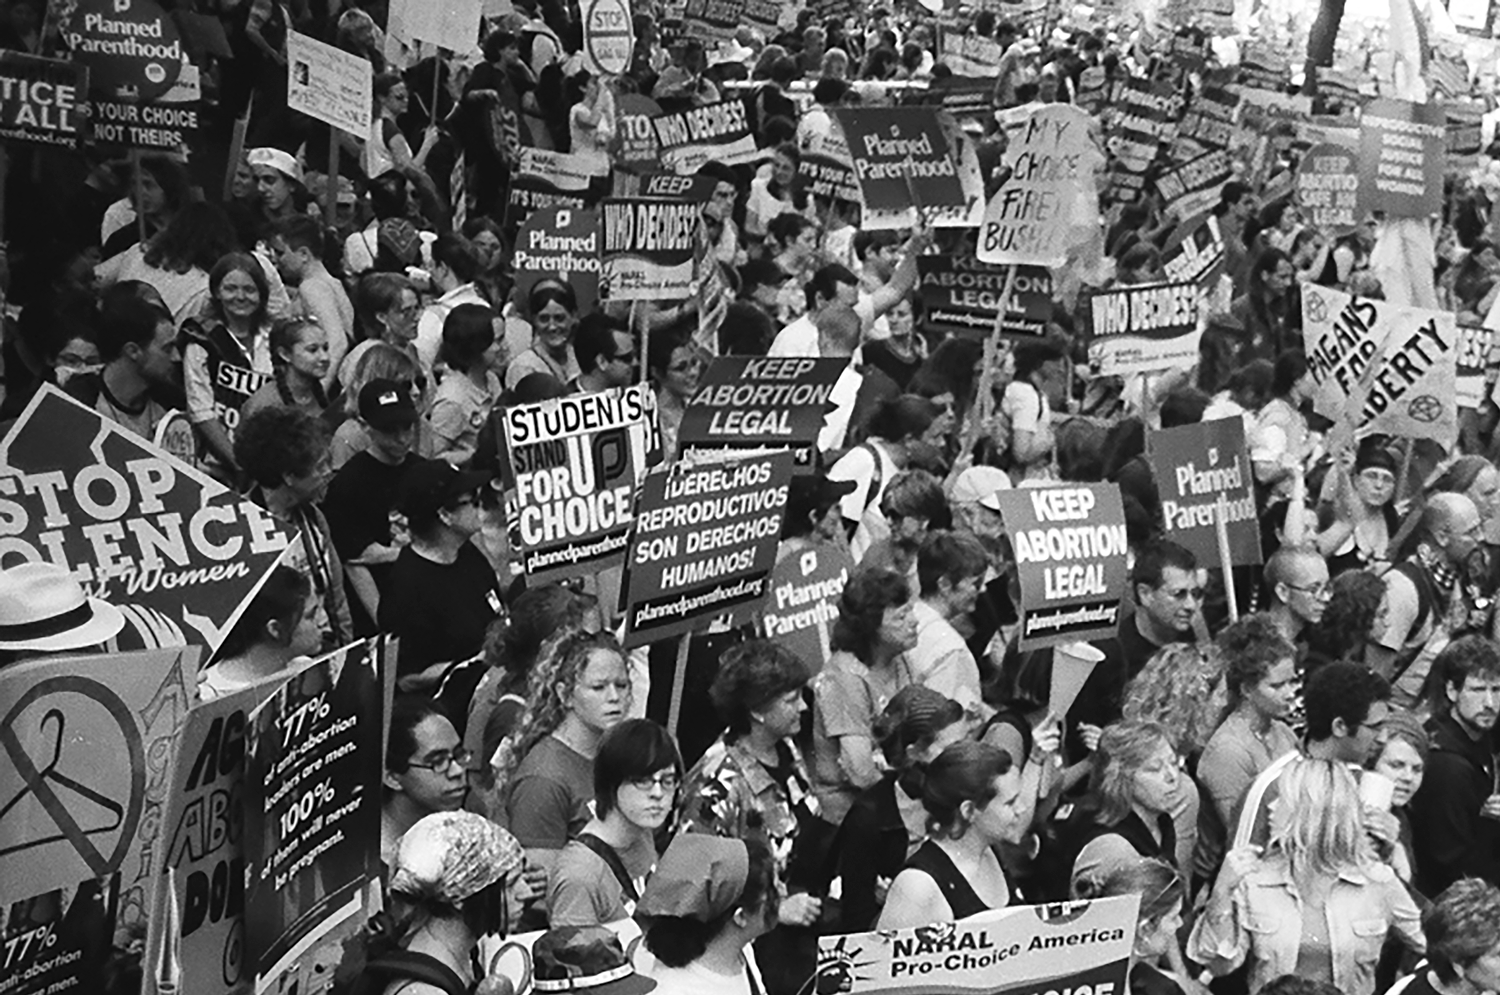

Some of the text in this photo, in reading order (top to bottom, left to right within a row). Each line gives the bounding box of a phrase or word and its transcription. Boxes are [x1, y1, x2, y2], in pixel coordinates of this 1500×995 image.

[85, 14, 162, 37] Planned
[596, 12, 622, 28] STOP
[70, 33, 181, 59] Parenthood
[14, 104, 76, 132] ALL
[97, 102, 138, 122] YOUR
[142, 107, 198, 128] CHOICE
[654, 99, 749, 147] WHO DECIDES?
[1024, 116, 1070, 144] MY
[129, 127, 183, 147] THEIRS
[863, 133, 932, 155] Planned
[647, 177, 693, 194] KEEP
[530, 230, 596, 253] Planned
[604, 203, 697, 251] WHO DECIDES?
[514, 252, 600, 272] Parenthoo
[923, 272, 1049, 294] ABORTON
[950, 289, 1026, 314] LEGAL
[1091, 283, 1199, 336] WHO DECIDES?
[1306, 295, 1379, 387] PAGANS
[740, 358, 815, 379] KEEP
[691, 383, 832, 407] ABORTION
[510, 389, 642, 442] STUDENTS
[708, 409, 793, 435] LEGAL
[514, 439, 566, 474] STAND
[516, 465, 572, 508] FOR
[1176, 457, 1242, 498] Planned
[0, 457, 176, 536] STOP
[636, 485, 788, 534] REPRODUCTIVOS
[1030, 488, 1095, 522] KEEP
[520, 485, 633, 546] CHOICE
[635, 514, 781, 564] SON DERECHOS
[1016, 523, 1128, 564] ABORTION
[120, 560, 251, 596] Women
[660, 546, 757, 589] HUMANOS!
[1044, 563, 1109, 601] LEGAL
[634, 578, 763, 627] plannedparenthood.org
[283, 691, 331, 749] 77%
[325, 740, 357, 765] men.
[280, 776, 336, 841] 100%
[4, 921, 58, 970] 77%
[890, 925, 1125, 978] Pro-Choice America
[891, 930, 996, 960] NARAL
